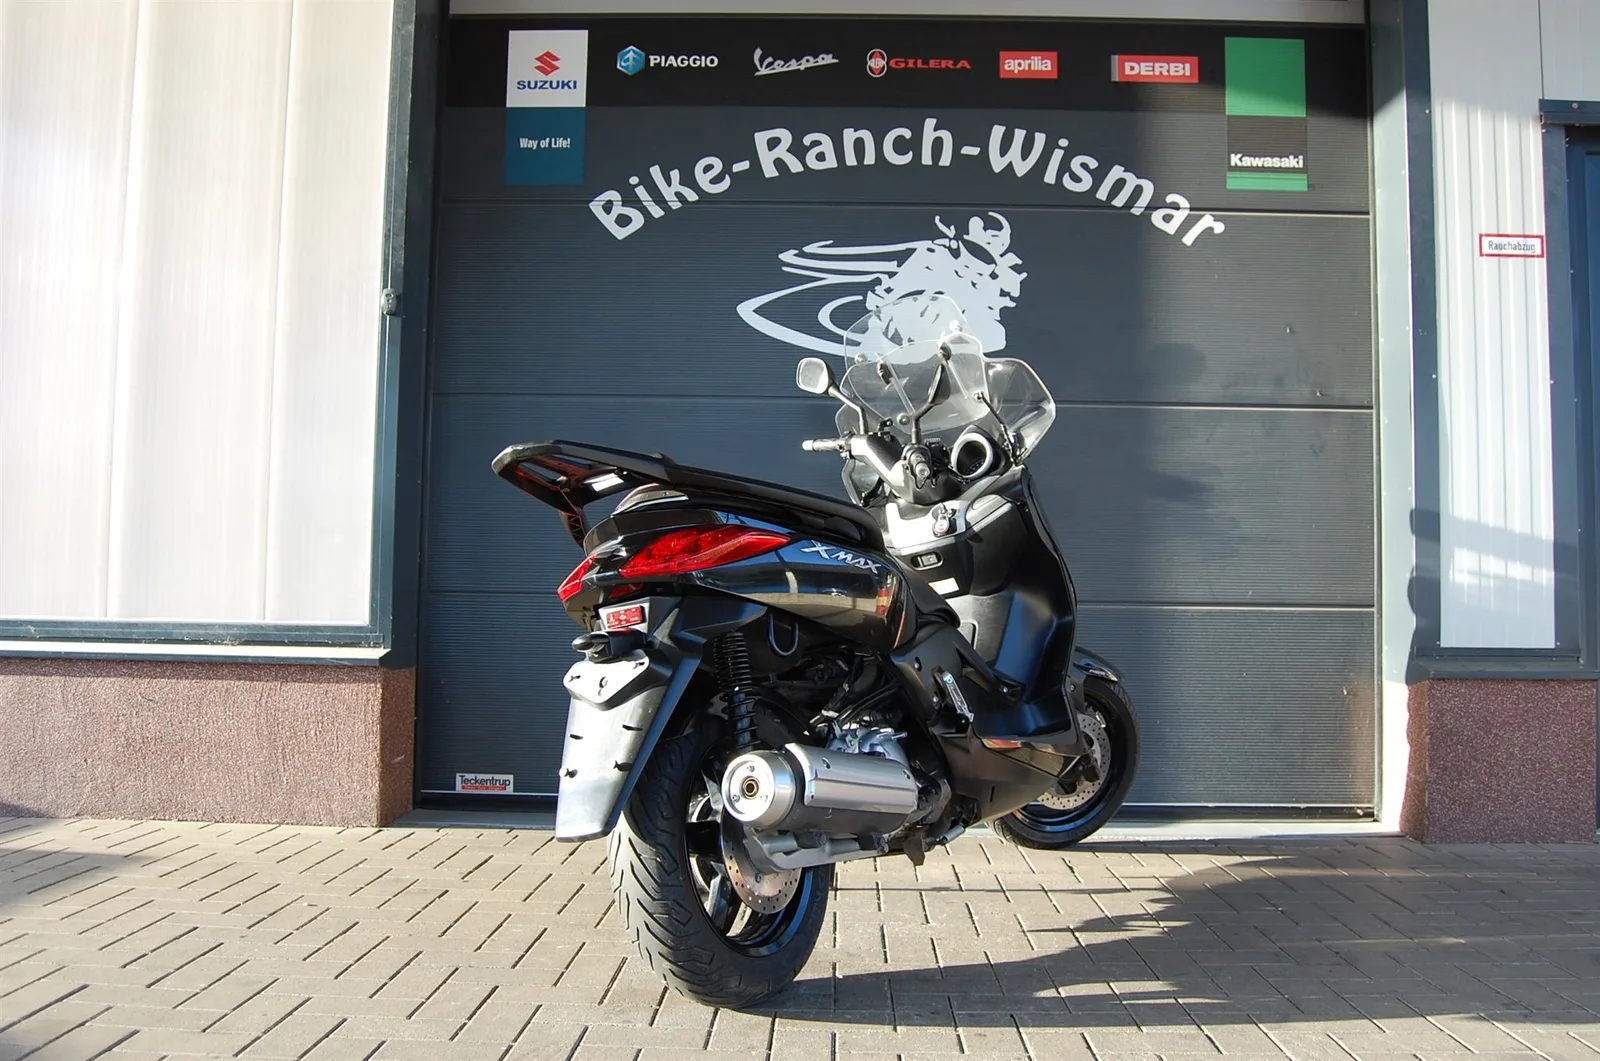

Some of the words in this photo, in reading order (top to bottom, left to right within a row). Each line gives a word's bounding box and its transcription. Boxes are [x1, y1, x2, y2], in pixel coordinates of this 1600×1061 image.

[648, 55, 719, 68] PIAGGIO
[753, 47, 840, 76] Vespa
[888, 57, 972, 70] GILERA
[1003, 55, 1053, 74] aprilia
[1123, 61, 1192, 77] DERBI
[516, 79, 578, 91] SUZUKI
[519, 137, 539, 151] Way
[540, 137, 550, 149] of
[551, 137, 571, 149] Life!
[1229, 153, 1304, 169] Kawasaki
[588, 116, 1226, 248] Bike-Ranch-Wismar
[1488, 240, 1536, 253] Rauchabzug
[459, 775, 511, 790] Teckentrup
